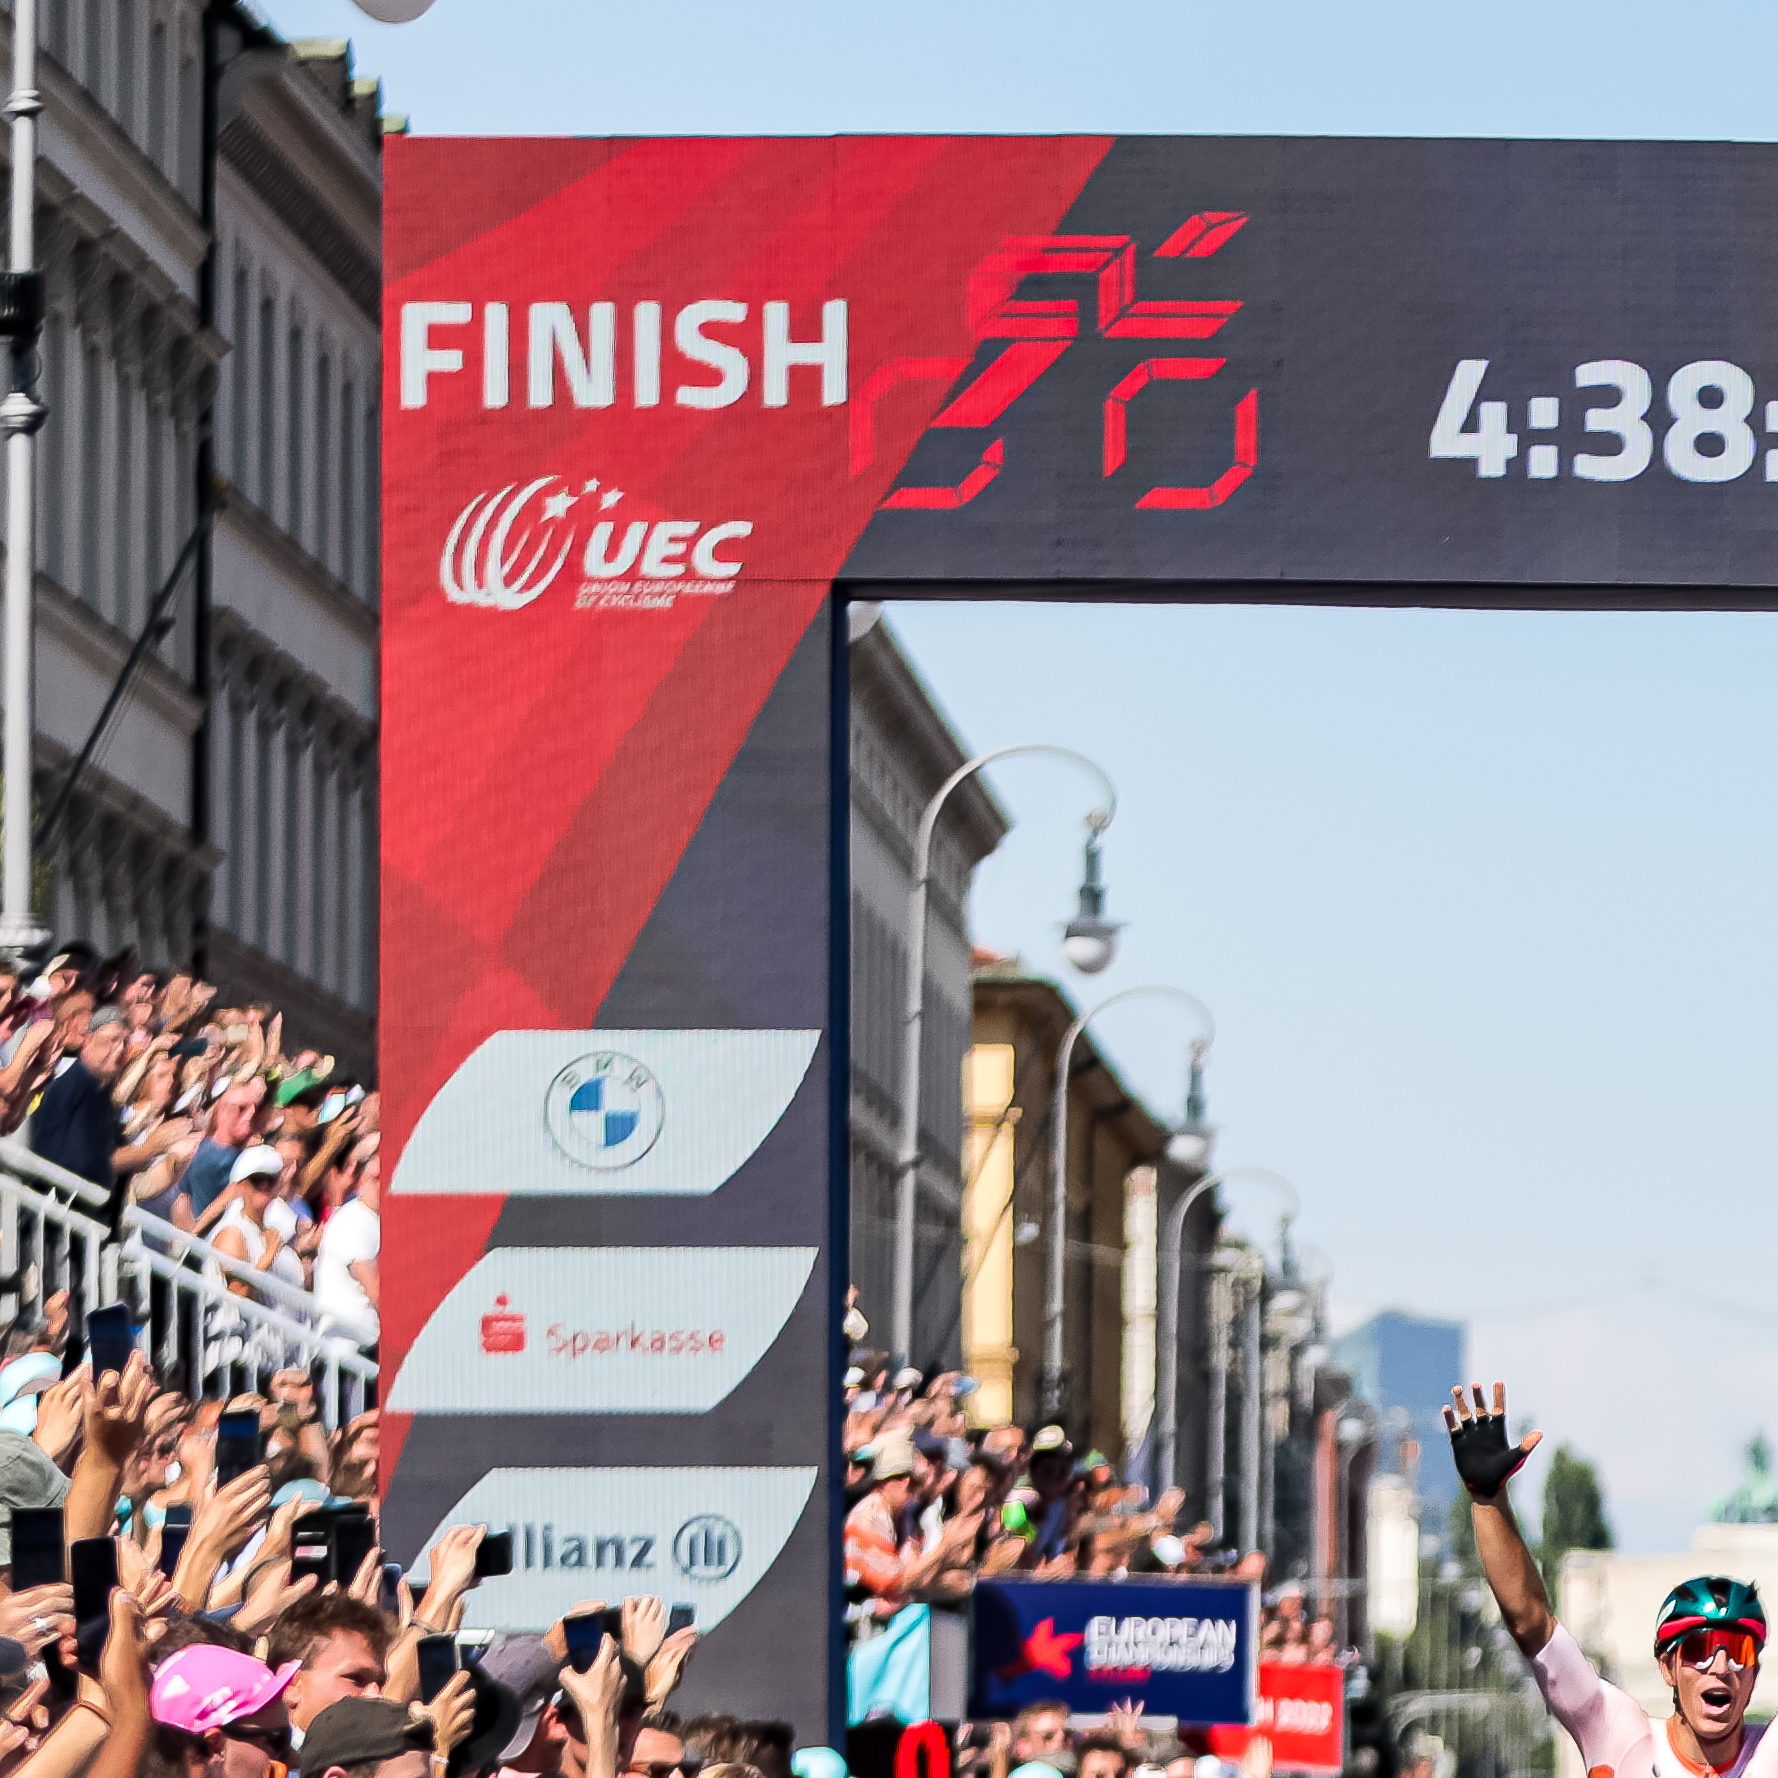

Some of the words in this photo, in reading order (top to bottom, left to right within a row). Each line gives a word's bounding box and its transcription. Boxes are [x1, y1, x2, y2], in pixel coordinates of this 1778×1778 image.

[399, 298, 849, 410] FINISH
[583, 520, 755, 579] UEC
[546, 1321, 727, 1360] Sparkasse
[488, 1520, 657, 1571] llianz
[1085, 1615, 1238, 1644] EUROPEAN
